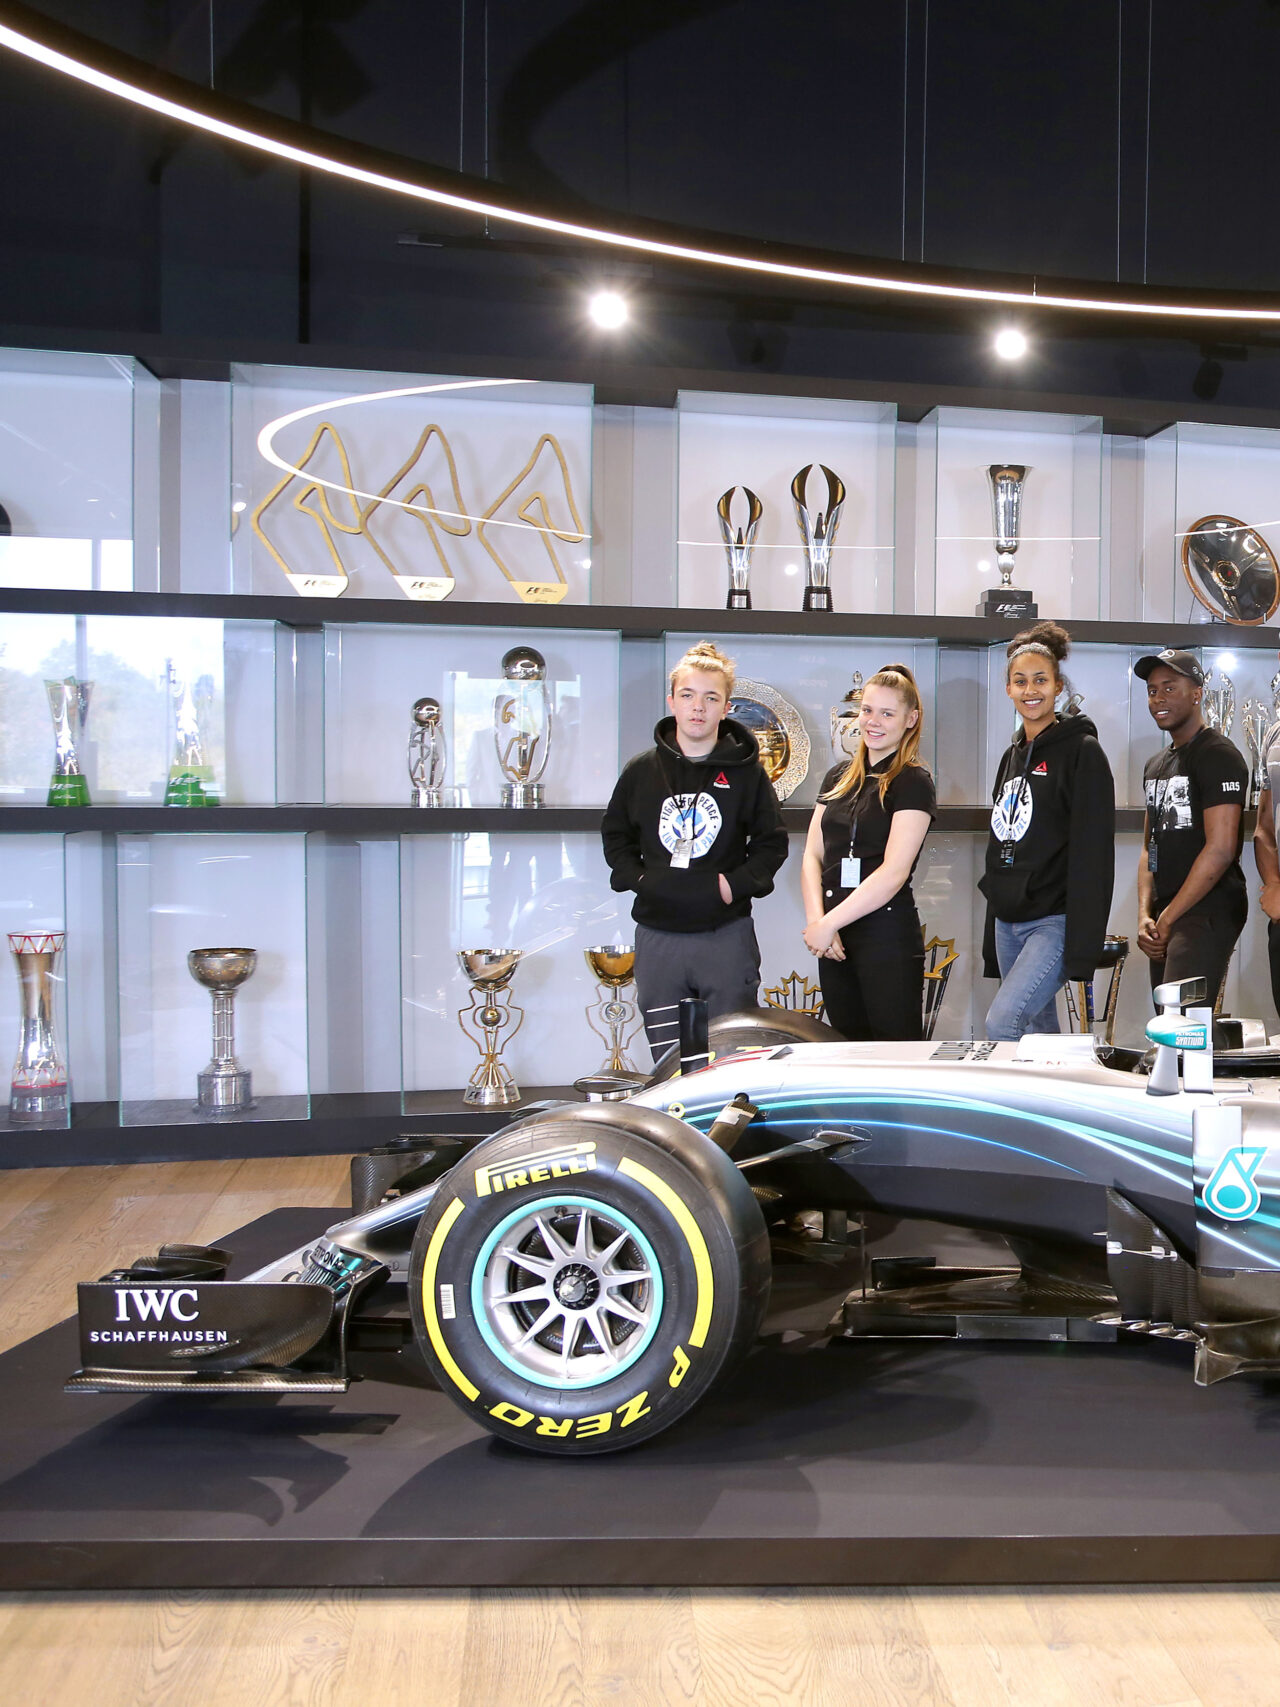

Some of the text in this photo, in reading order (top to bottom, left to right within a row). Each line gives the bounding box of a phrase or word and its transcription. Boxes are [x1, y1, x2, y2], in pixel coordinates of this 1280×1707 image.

[1221, 781, 1241, 792] nas
[698, 796, 719, 821] PEACE
[474, 1141, 597, 1197] PIRELLI
[114, 1288, 200, 1322] IWC
[90, 1330, 229, 1342] SCHAFFHAUSEN
[488, 1345, 691, 1439] P ZERO
